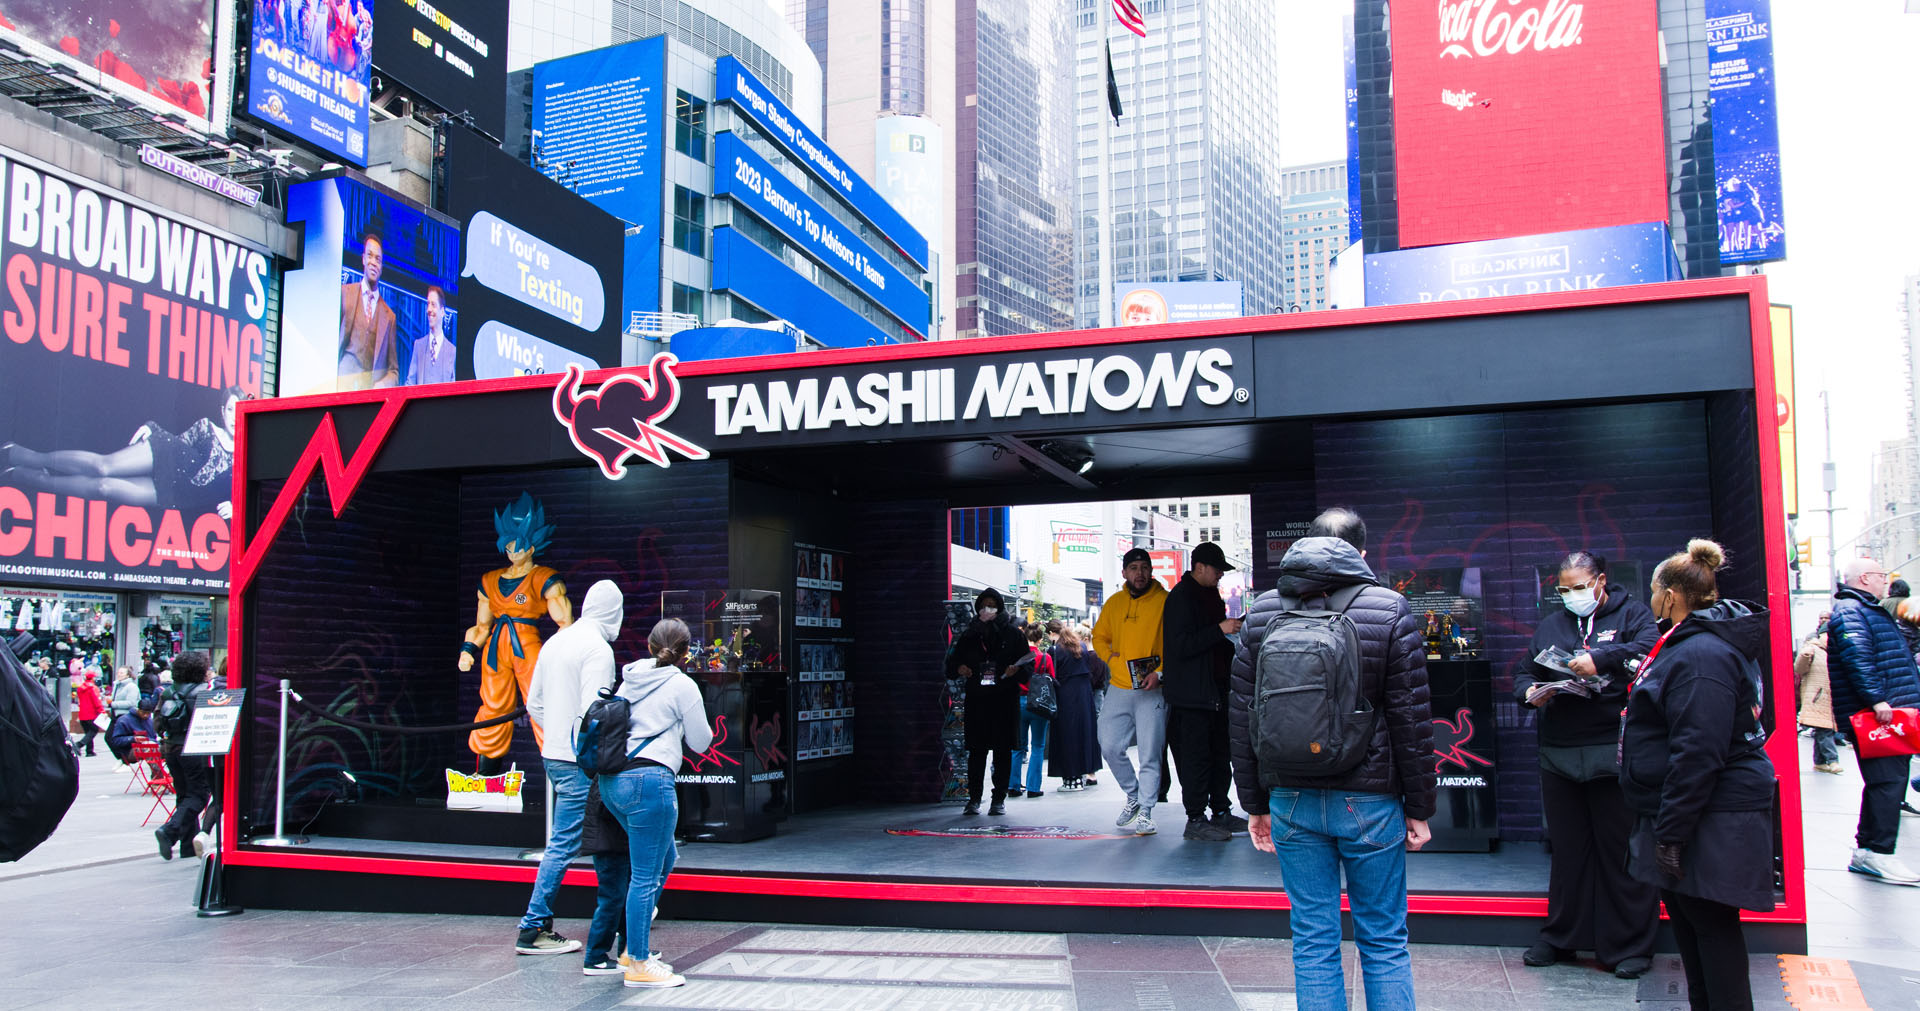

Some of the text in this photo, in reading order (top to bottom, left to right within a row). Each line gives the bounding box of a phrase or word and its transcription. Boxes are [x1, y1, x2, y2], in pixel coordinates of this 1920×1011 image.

[277, 72, 317, 103] SHUBERT
[319, 92, 356, 123] THEATRE
[334, 70, 367, 108] HOT
[736, 72, 766, 116] Morgan
[768, 101, 794, 144] Stanley
[796, 129, 839, 181] Congratulates
[841, 171, 853, 193] Our
[146, 150, 256, 205] OUTFRONT PRIME
[10, 164, 267, 321] BROADWAY'S
[490, 222, 550, 270] If You're
[735, 155, 885, 291] 2023 Barron's Top Advisors & Teams
[1458, 253, 1562, 276] BLACKPINK
[517, 261, 583, 325] Texting
[4, 253, 262, 399] SURE THING
[496, 330, 544, 369] Who's
[707, 347, 1235, 436] TAMASHII NATIONS
[0, 486, 231, 573] CHICAG
[1286, 521, 1311, 529] WORLD
[156, 548, 209, 560] THE MUSICAL
[120, 574, 161, 585] AMBASSADOR
[163, 576, 186, 586] THEATRE
[205, 580, 223, 588] STREET
[447, 769, 506, 793] DRAGON BALL
